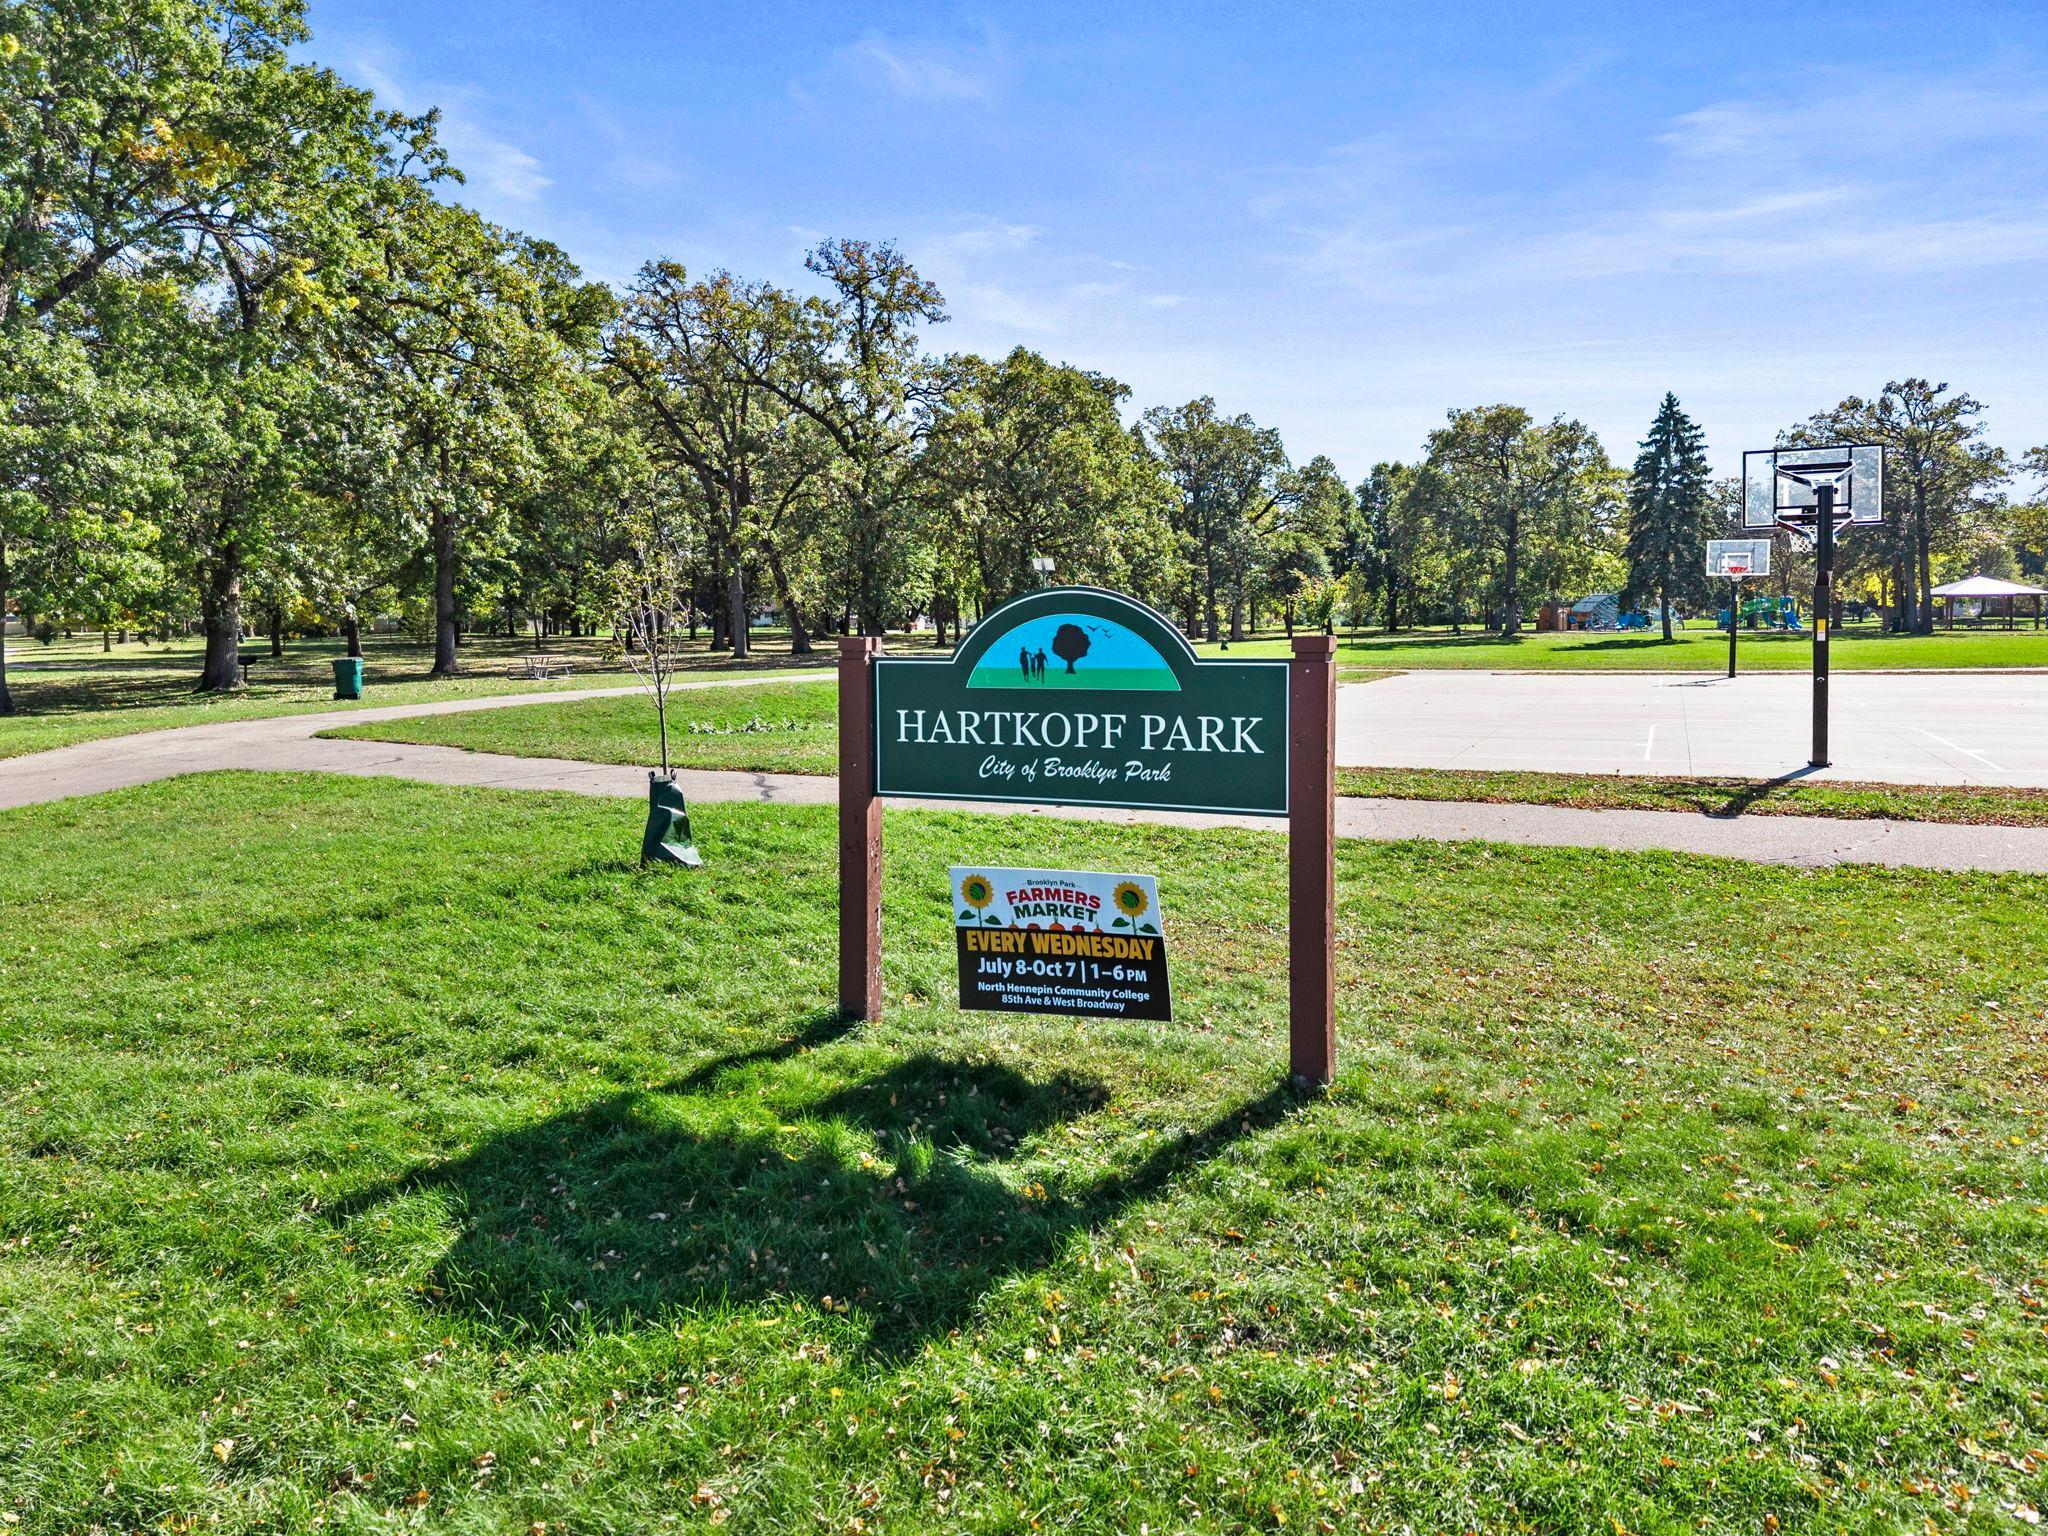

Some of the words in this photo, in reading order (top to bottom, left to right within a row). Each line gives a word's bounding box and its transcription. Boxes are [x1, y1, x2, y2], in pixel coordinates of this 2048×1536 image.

[897, 709, 1126, 749] HARTKOPF
[1140, 714, 1264, 754] PARK
[979, 755, 1016, 781] City
[1020, 757, 1038, 782] of
[1044, 759, 1118, 784] Brooklyn
[1124, 761, 1171, 783] Park
[1027, 879, 1058, 887] Brooklyn
[1060, 880, 1075, 888] Park
[1006, 887, 1101, 909] FARMERS
[1013, 903, 1098, 923] MARKET
[966, 930, 1027, 953] EVERY
[1031, 933, 1154, 960] WEDNESDAY
[978, 957, 1012, 978] July
[1066, 962, 1076, 977] 7
[1127, 969, 1147, 982] PM
[977, 982, 1005, 992] North
[1007, 983, 1052, 996] Hennepin
[1054, 985, 1111, 999] Community
[1112, 989, 1150, 1001] College
[1002, 995, 1023, 1004] 85th
[1025, 996, 1042, 1005] Ave
[1044, 997, 1051, 1005] &
[1052, 997, 1075, 1007] West
[1077, 999, 1125, 1012] Broadway
